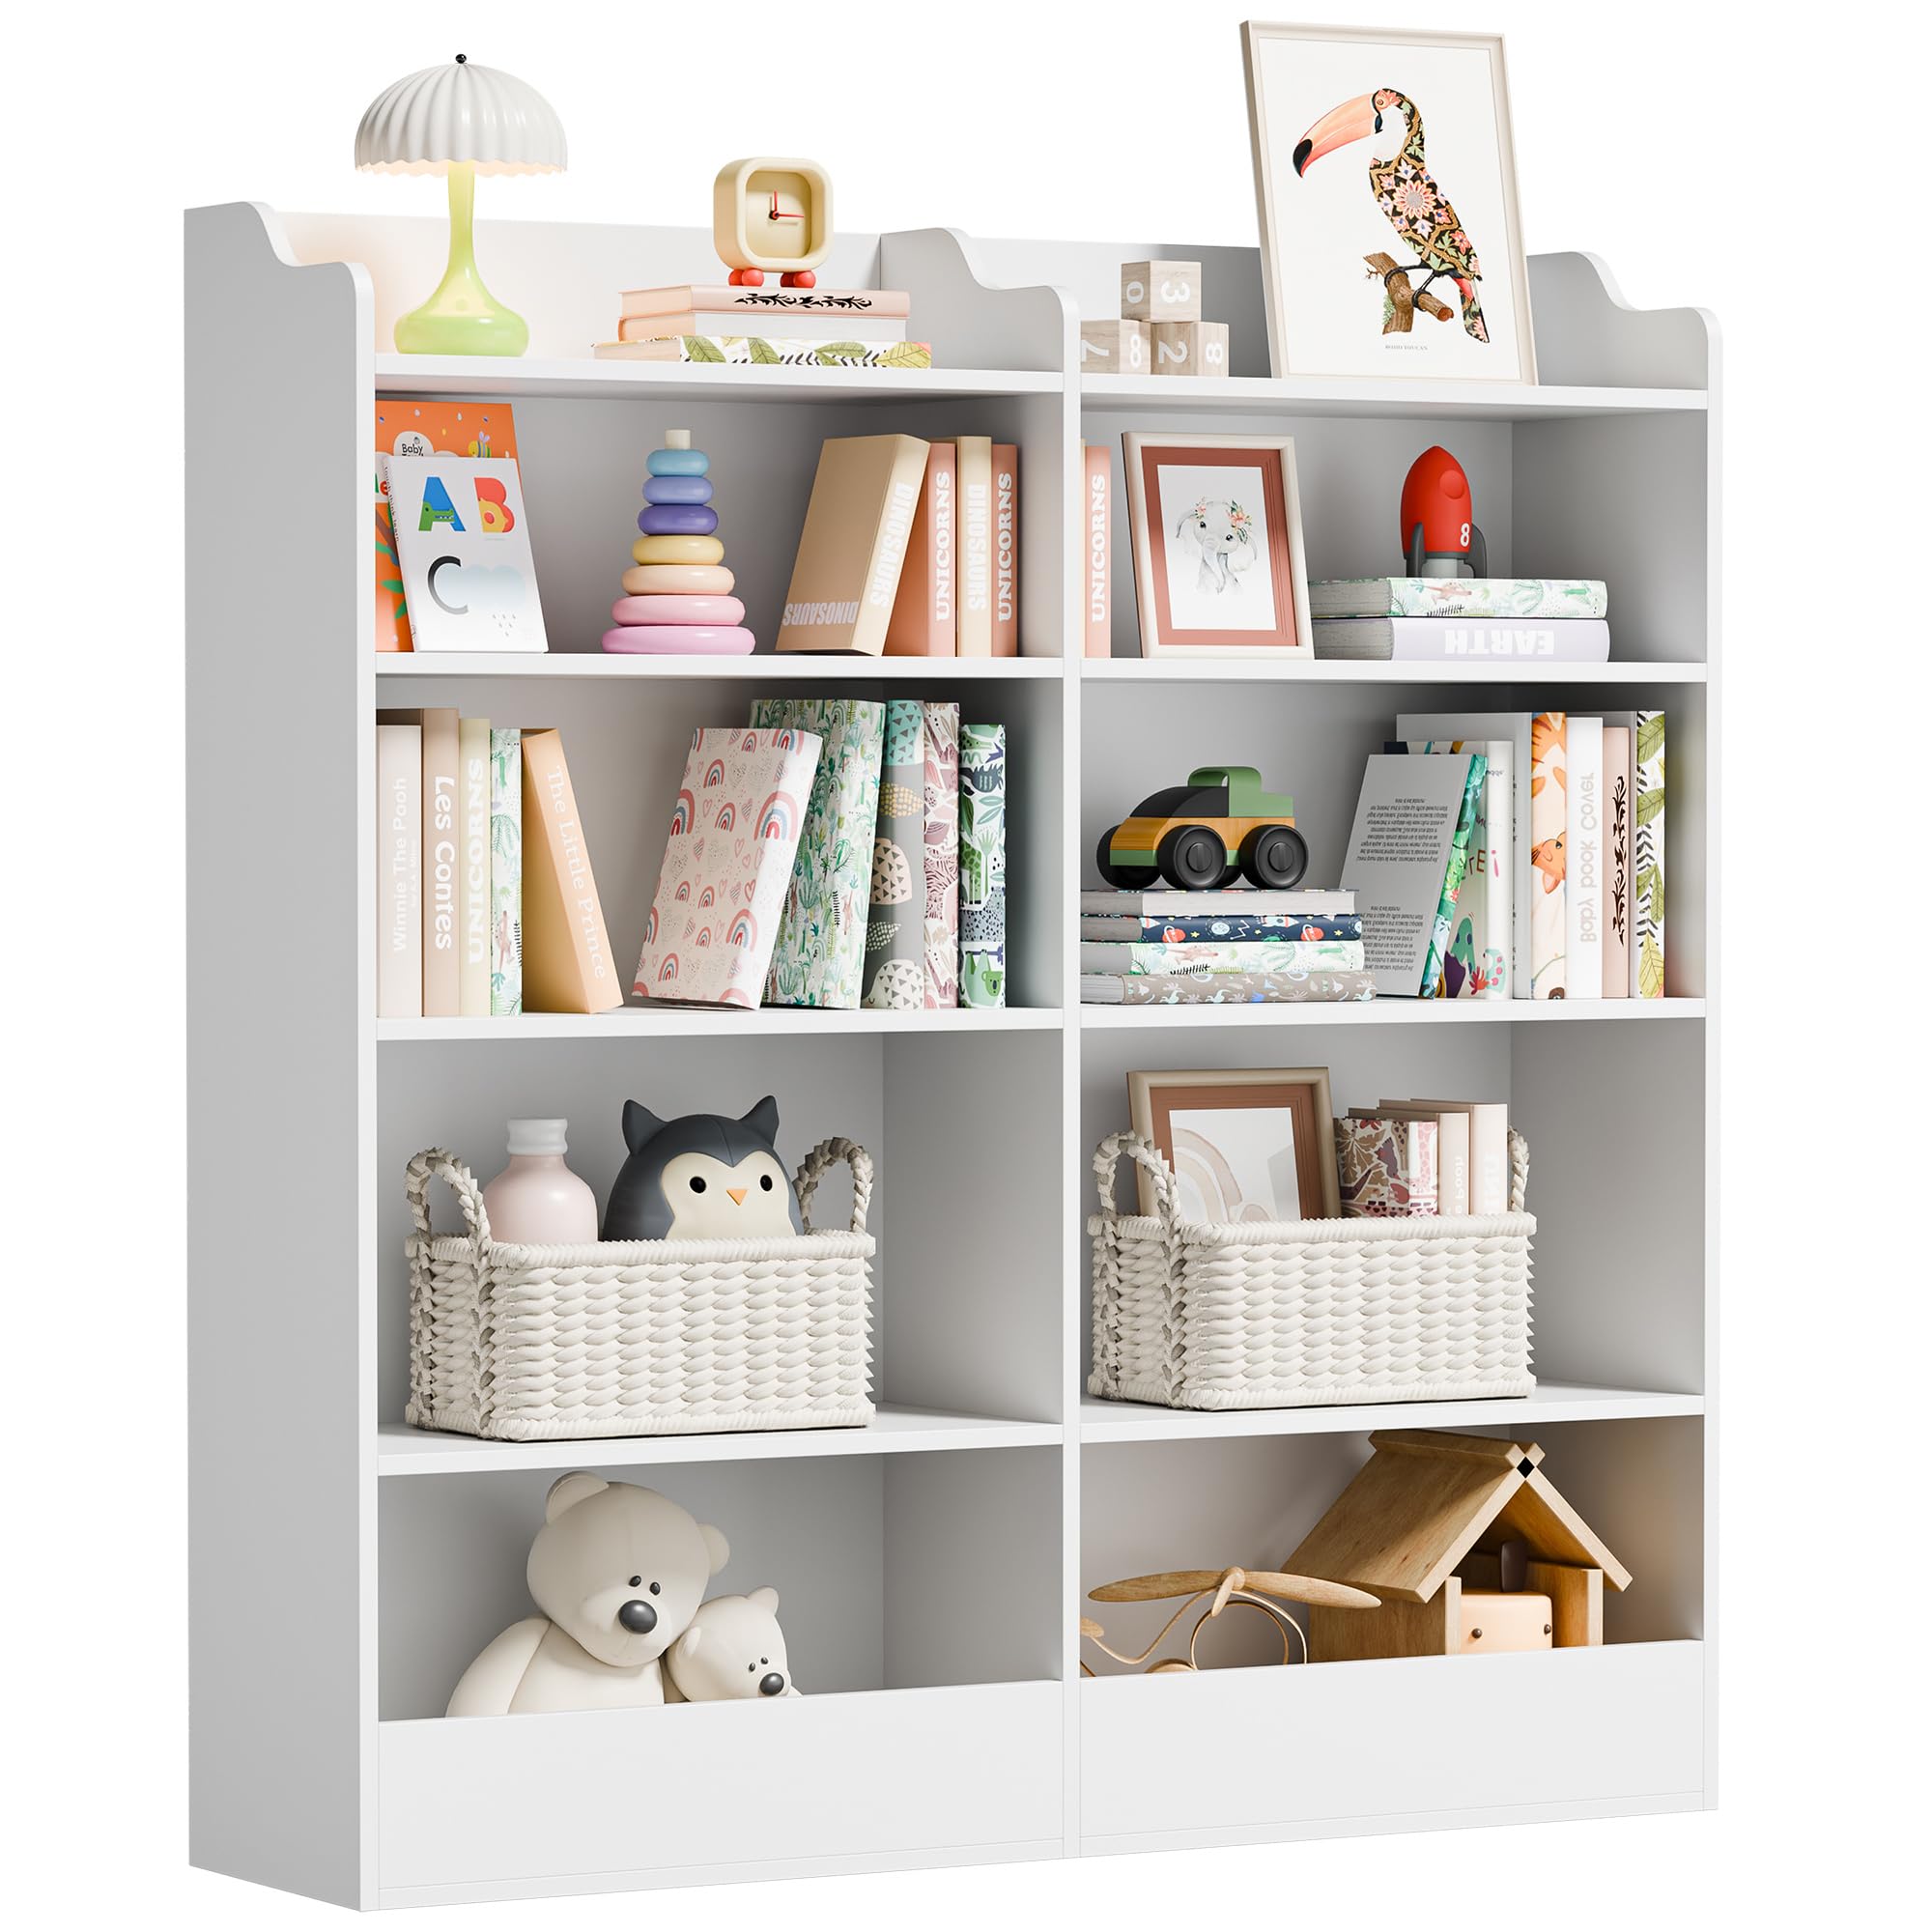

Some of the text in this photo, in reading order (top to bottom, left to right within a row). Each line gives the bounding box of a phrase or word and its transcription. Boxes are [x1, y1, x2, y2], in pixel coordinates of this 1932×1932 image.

[1160, 280, 1191, 303] 3
[1129, 333, 1142, 369] 8
[1159, 340, 1188, 363] 2
[1205, 342, 1223, 364] 8
[401, 443, 423, 457] Baby
[869, 482, 915, 609] DINOSAURS
[935, 469, 952, 623] UNICORNS
[967, 482, 988, 611] DINOSAURS
[997, 471, 1013, 623] UNICORNS
[1091, 472, 1107, 624] UNICORNS
[1460, 523, 1470, 547] 8
[427, 555, 469, 614] C
[781, 601, 859, 626] DINOSAURS
[1444, 629, 1554, 655] EARTH
[393, 778, 408, 952] Winnie The Pooh
[434, 776, 455, 950] Les Contes
[468, 758, 485, 964] UNICORNS
[548, 765, 606, 979] The Little Prince
